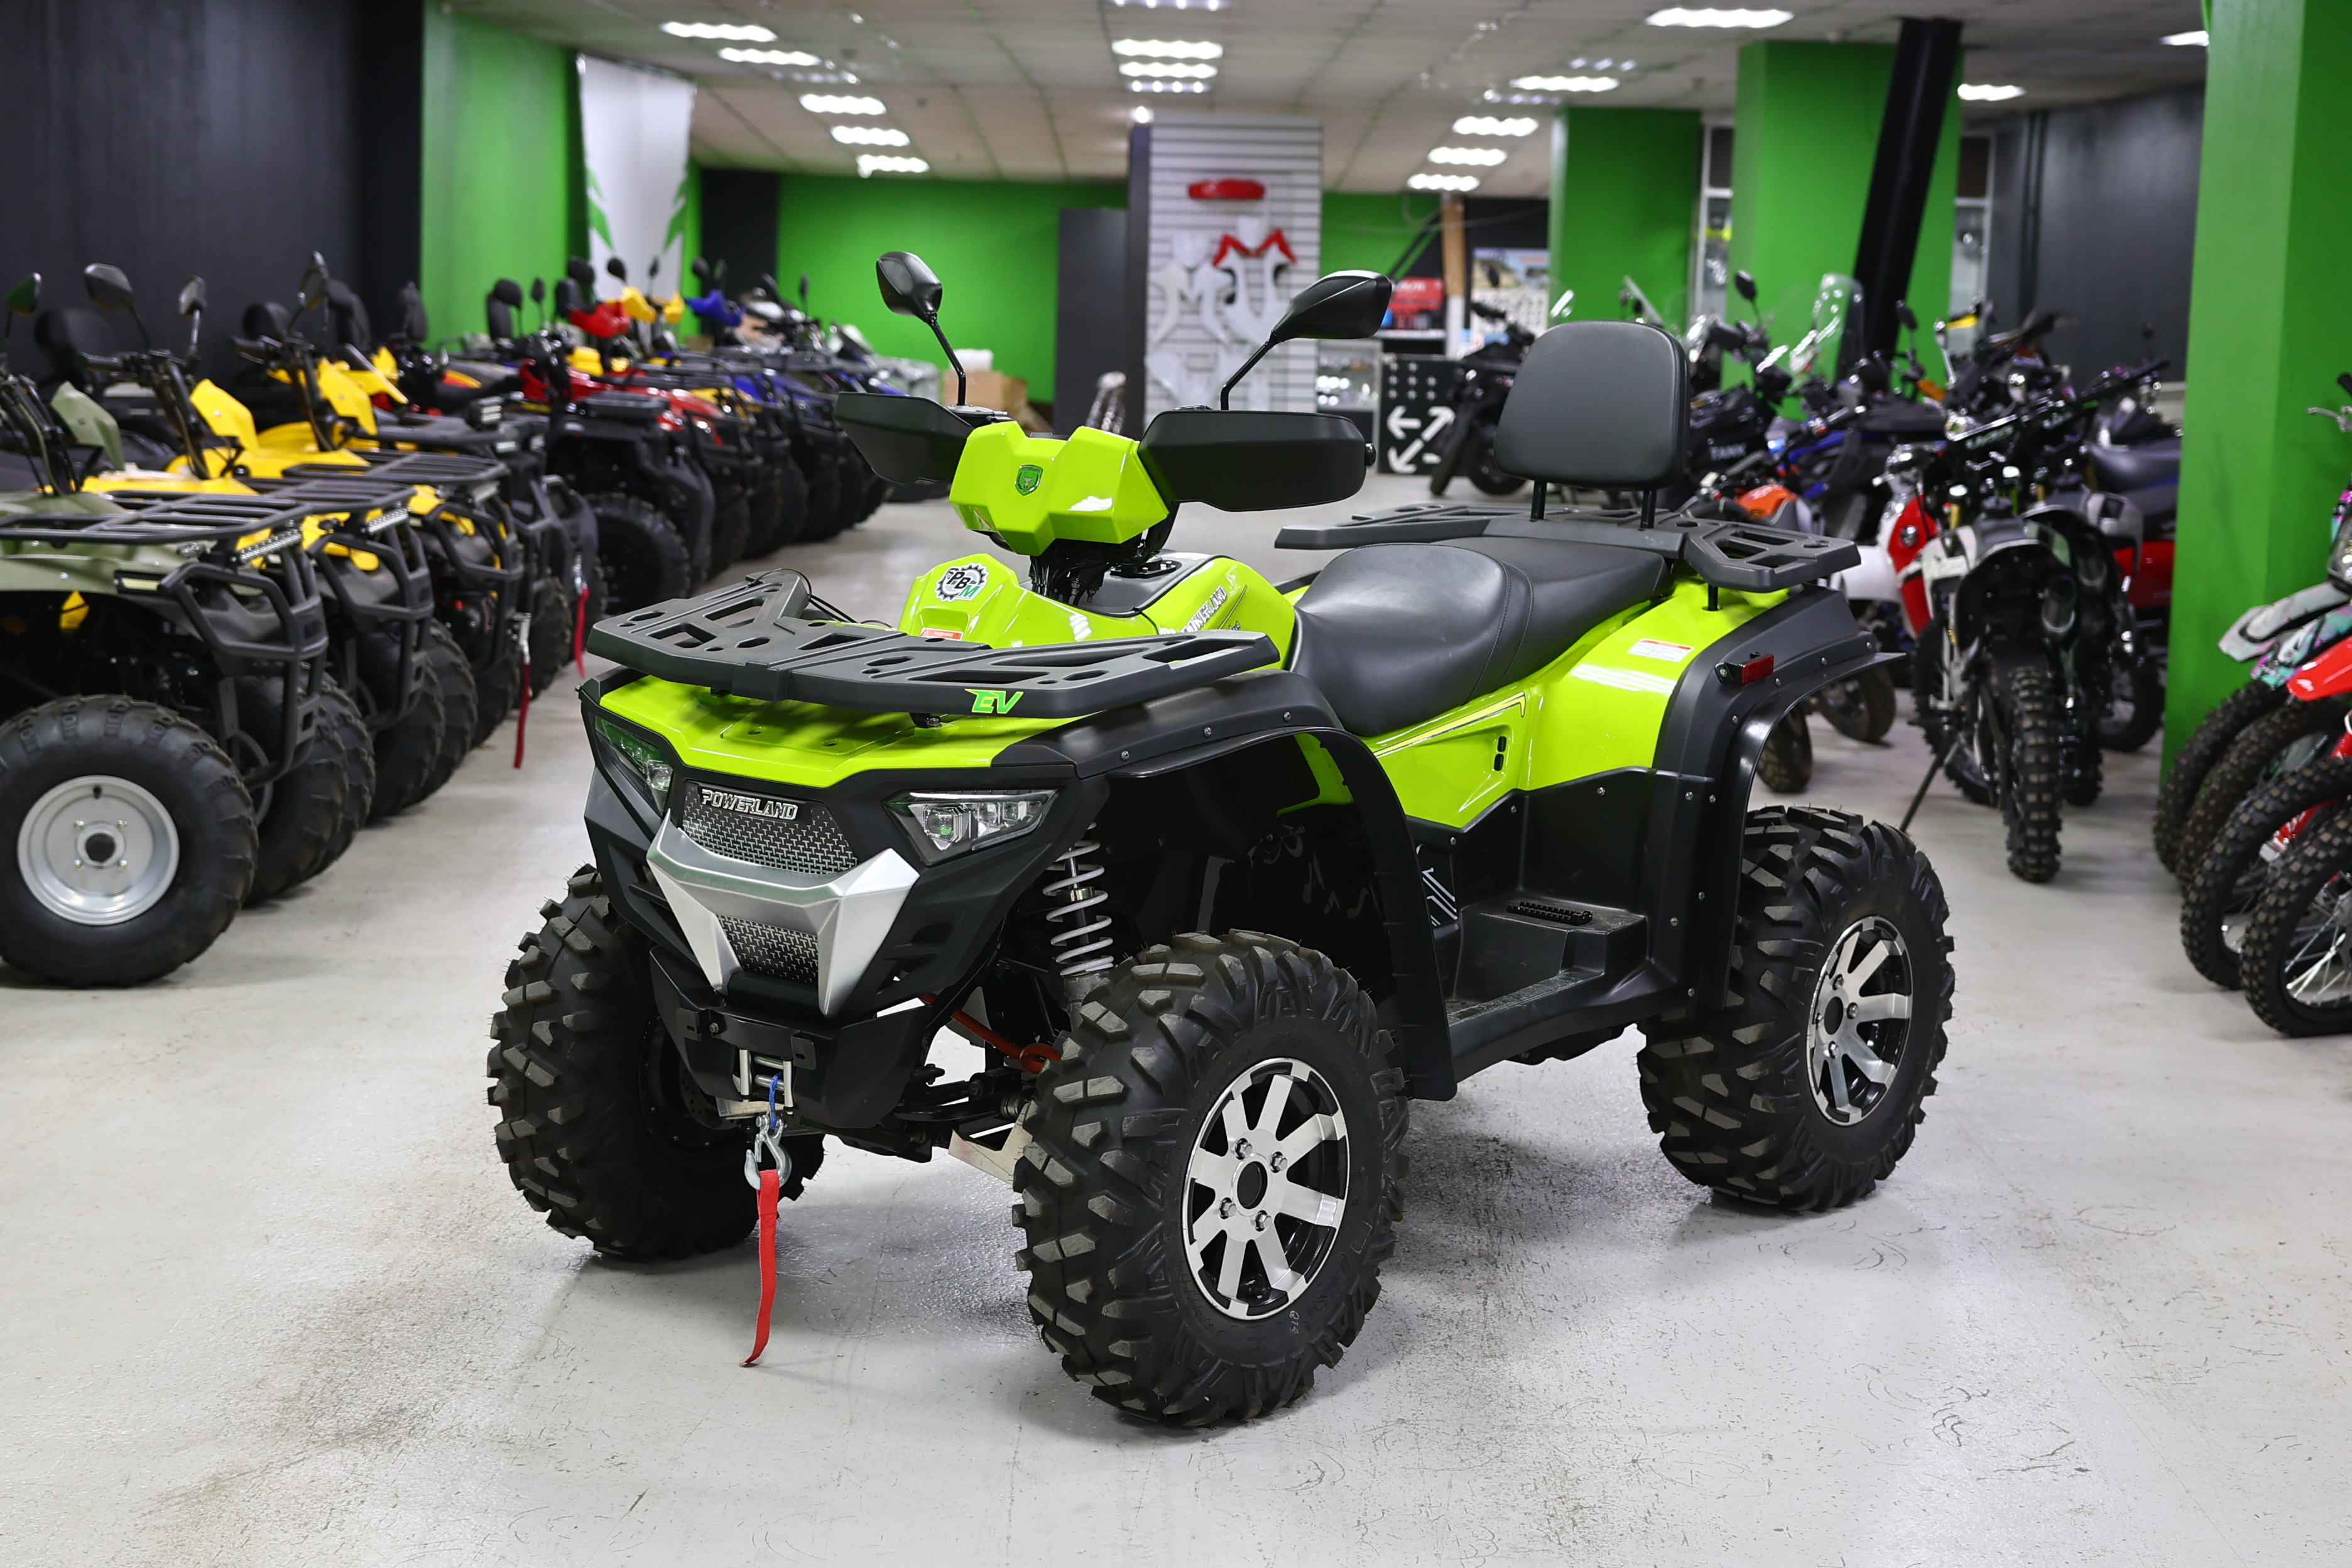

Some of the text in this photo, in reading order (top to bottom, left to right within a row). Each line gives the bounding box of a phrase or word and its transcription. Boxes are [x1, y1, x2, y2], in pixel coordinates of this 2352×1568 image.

[934, 630, 954, 638] WARNING
[964, 689, 1025, 714] EV
[702, 788, 798, 820] POWERLAND
